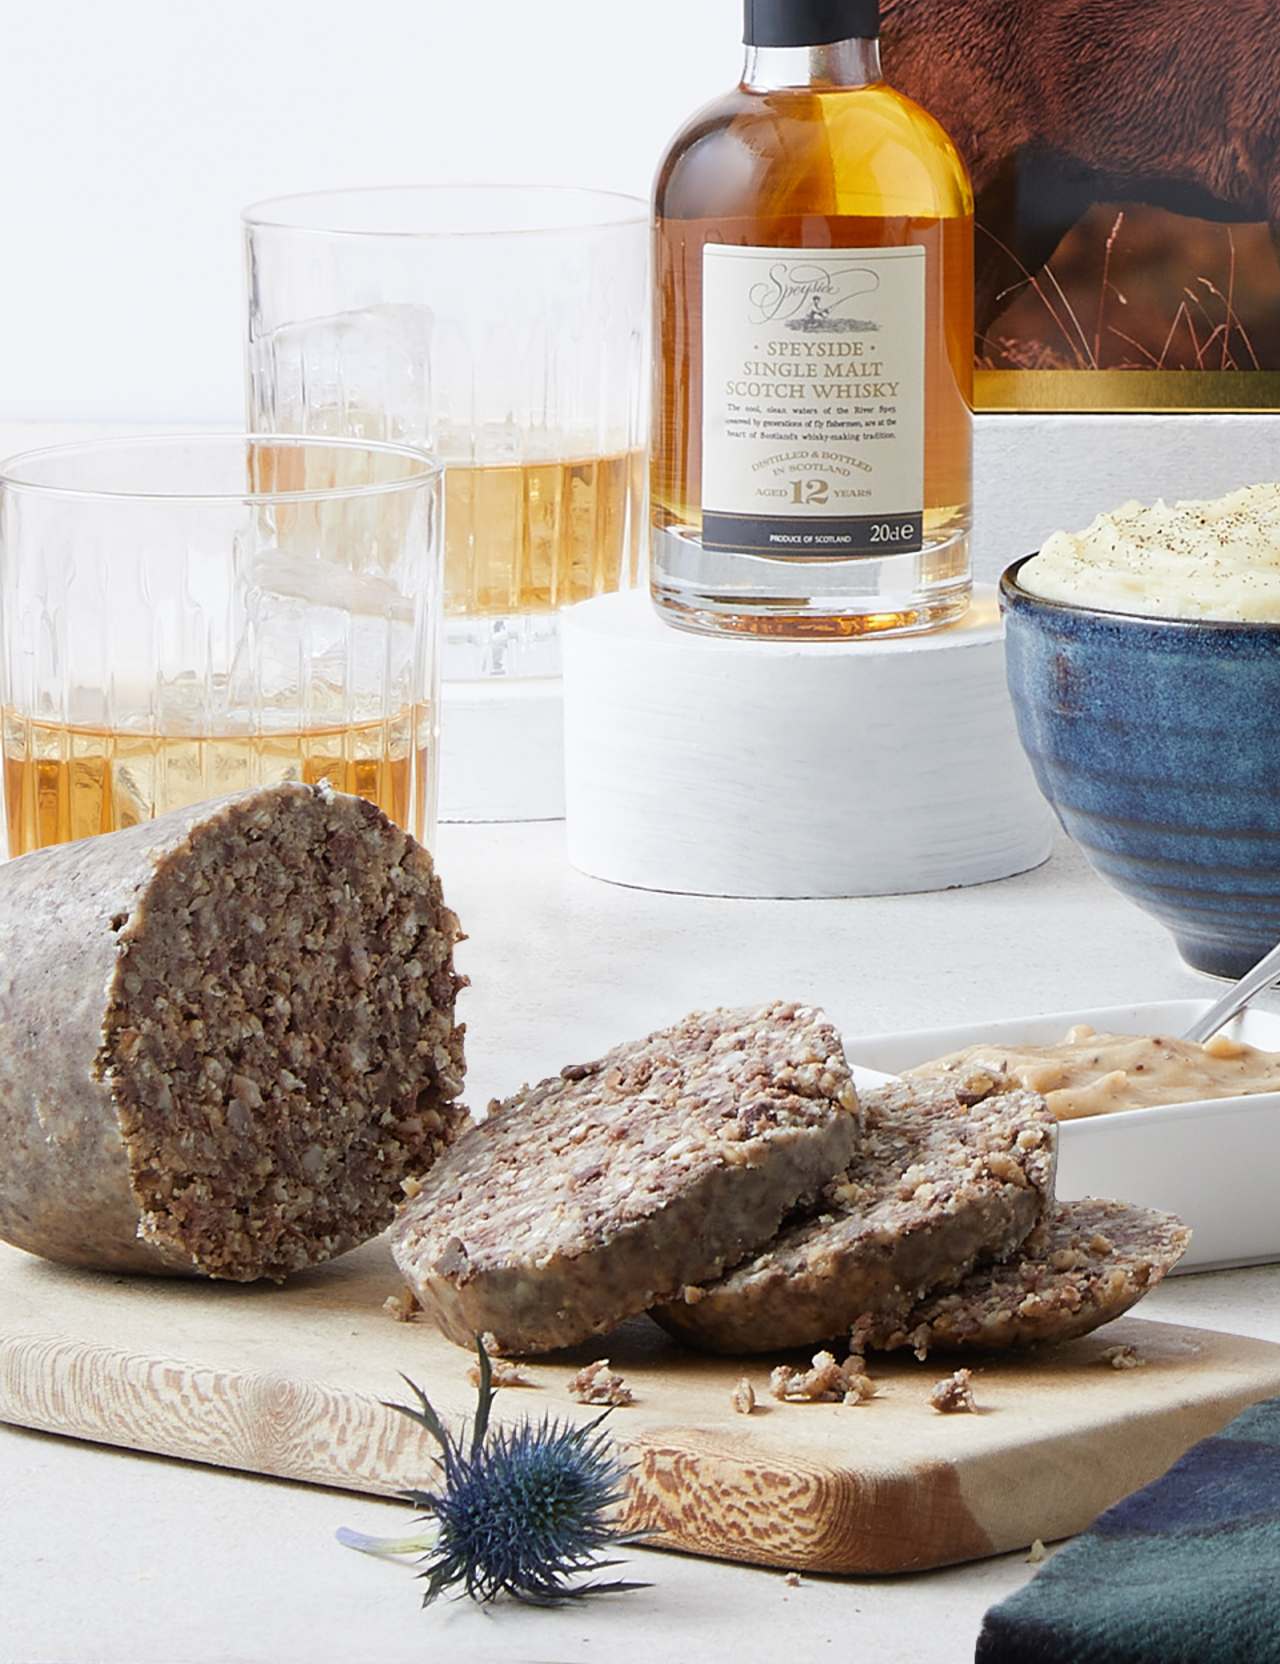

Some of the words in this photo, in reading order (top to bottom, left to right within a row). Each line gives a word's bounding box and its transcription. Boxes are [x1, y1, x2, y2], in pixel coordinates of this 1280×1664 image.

[767, 341, 864, 357] SPEYSIDE
[744, 361, 817, 378] SINGLE
[824, 362, 884, 378] MALT
[726, 380, 806, 399] SCOTCH
[811, 382, 900, 399] WHISKY
[752, 450, 809, 472] DISTILLED
[811, 451, 820, 459] &
[822, 451, 873, 473] BOTTLED
[773, 467, 785, 476] IN
[789, 463, 851, 477] SCOTLAND
[755, 488, 788, 497] AGED
[789, 479, 829, 505] 12
[833, 488, 873, 498] YEARS
[769, 534, 802, 543] PRODUCE
[803, 534, 814, 543] OF
[815, 534, 852, 543] SCOTLAND
